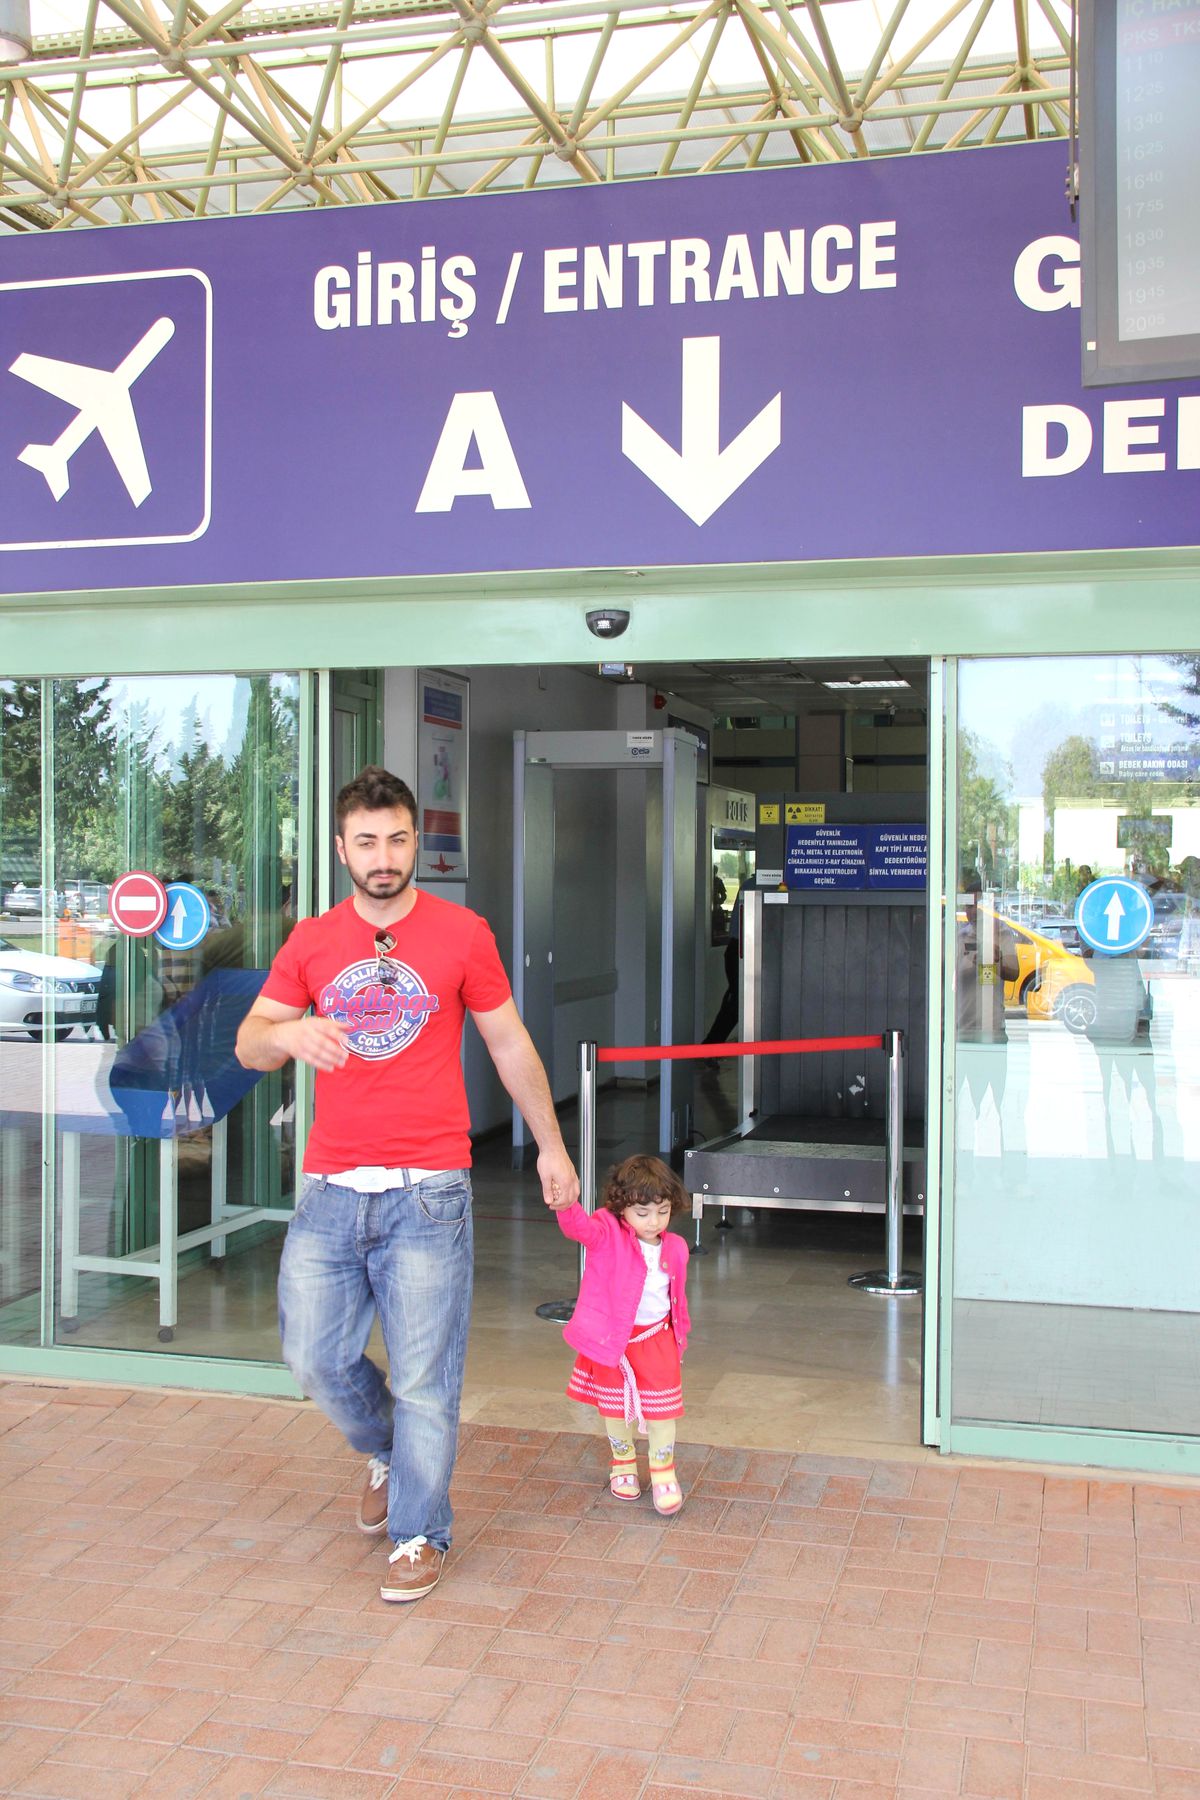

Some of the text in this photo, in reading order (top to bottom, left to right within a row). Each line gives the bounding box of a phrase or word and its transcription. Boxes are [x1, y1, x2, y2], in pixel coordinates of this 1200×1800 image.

[313, 220, 898, 339] GİRİŞ / ENTRANCE
[414, 390, 533, 514] A
[815, 828, 841, 837] GÜVENLİK
[879, 832, 909, 842] GÜVENLİK
[832, 847, 864, 856] ELEKTRONİK
[875, 845, 889, 853] KAPI
[890, 844, 902, 853] TİPİ
[903, 845, 922, 853] METAL
[794, 867, 857, 875] BIRAKARAK KONTROLDEN
[869, 866, 889, 876] SİNYAL
[890, 868, 922, 876] VERMEDEN
[357, 1019, 413, 1047] COLLEGE
